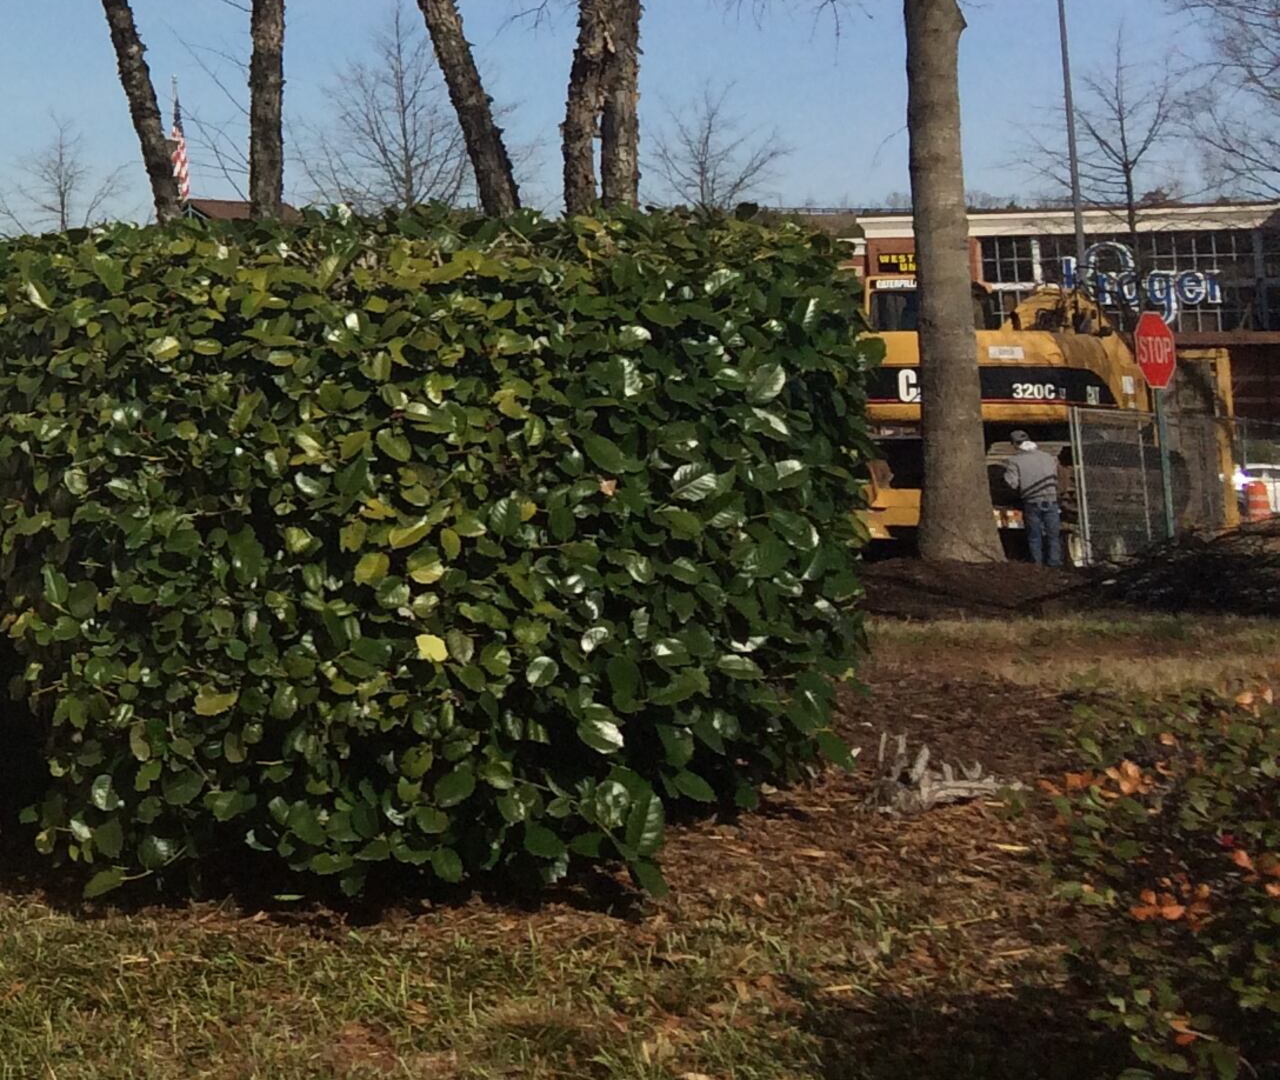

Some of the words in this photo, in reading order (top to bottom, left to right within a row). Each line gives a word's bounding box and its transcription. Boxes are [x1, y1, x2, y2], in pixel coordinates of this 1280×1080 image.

[879, 254, 915, 263] WEST
[1139, 336, 1171, 363] STOP
[1012, 383, 1056, 399] 320C
